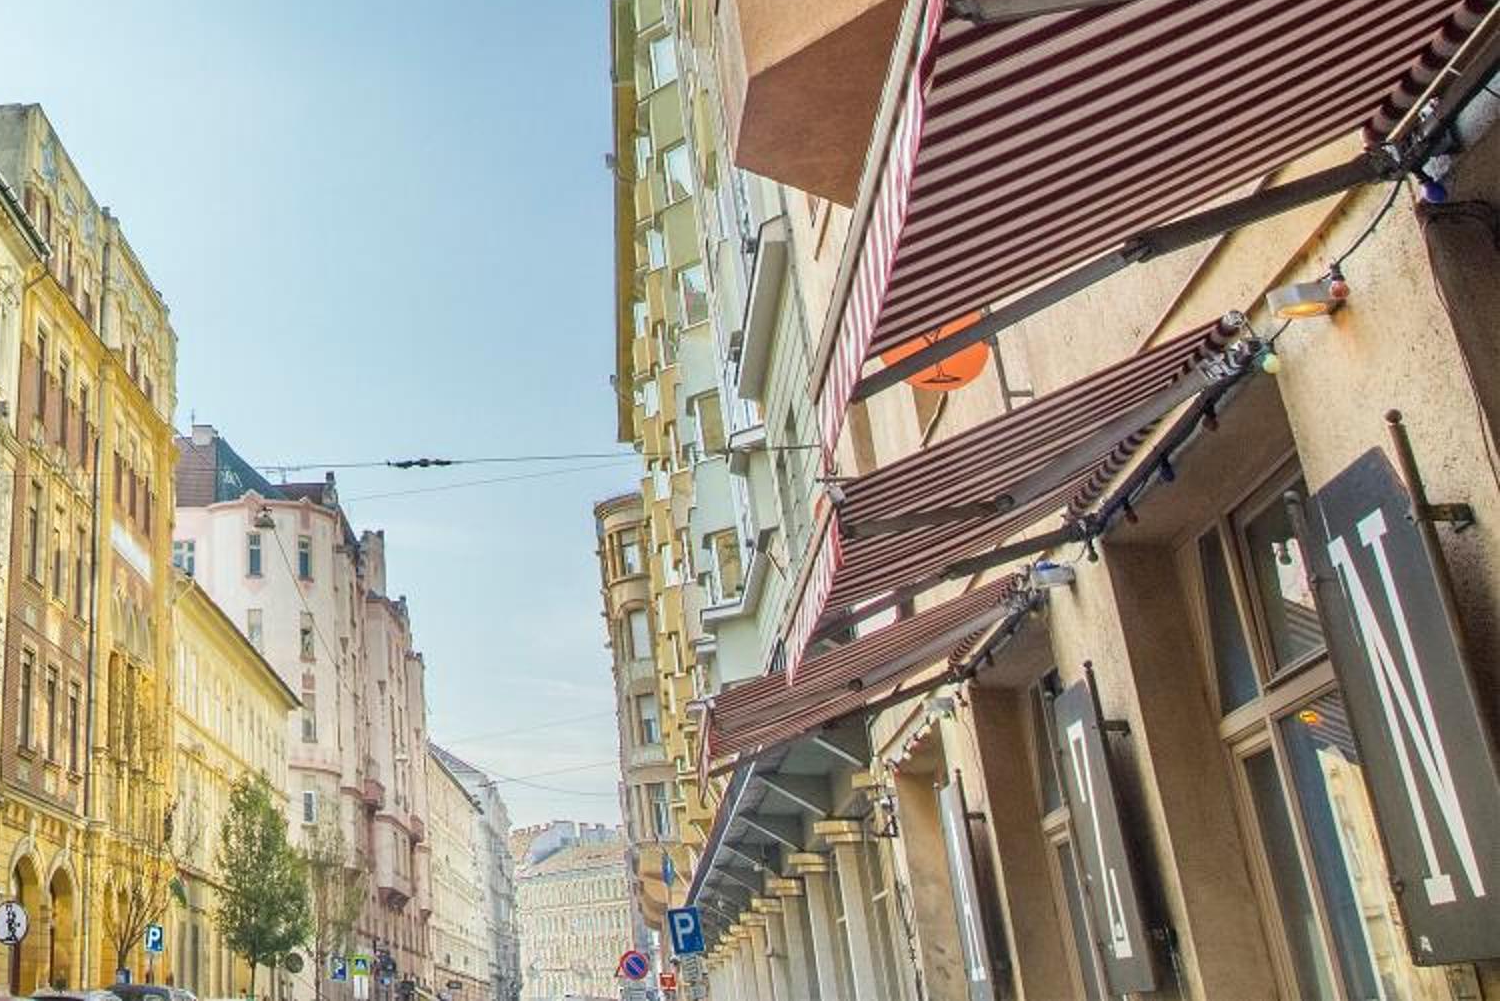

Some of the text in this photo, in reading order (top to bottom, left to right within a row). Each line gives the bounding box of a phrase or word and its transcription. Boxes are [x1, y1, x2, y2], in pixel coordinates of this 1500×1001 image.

[1327, 508, 1486, 904] N
[148, 928, 160, 947] P
[673, 912, 695, 949] P
